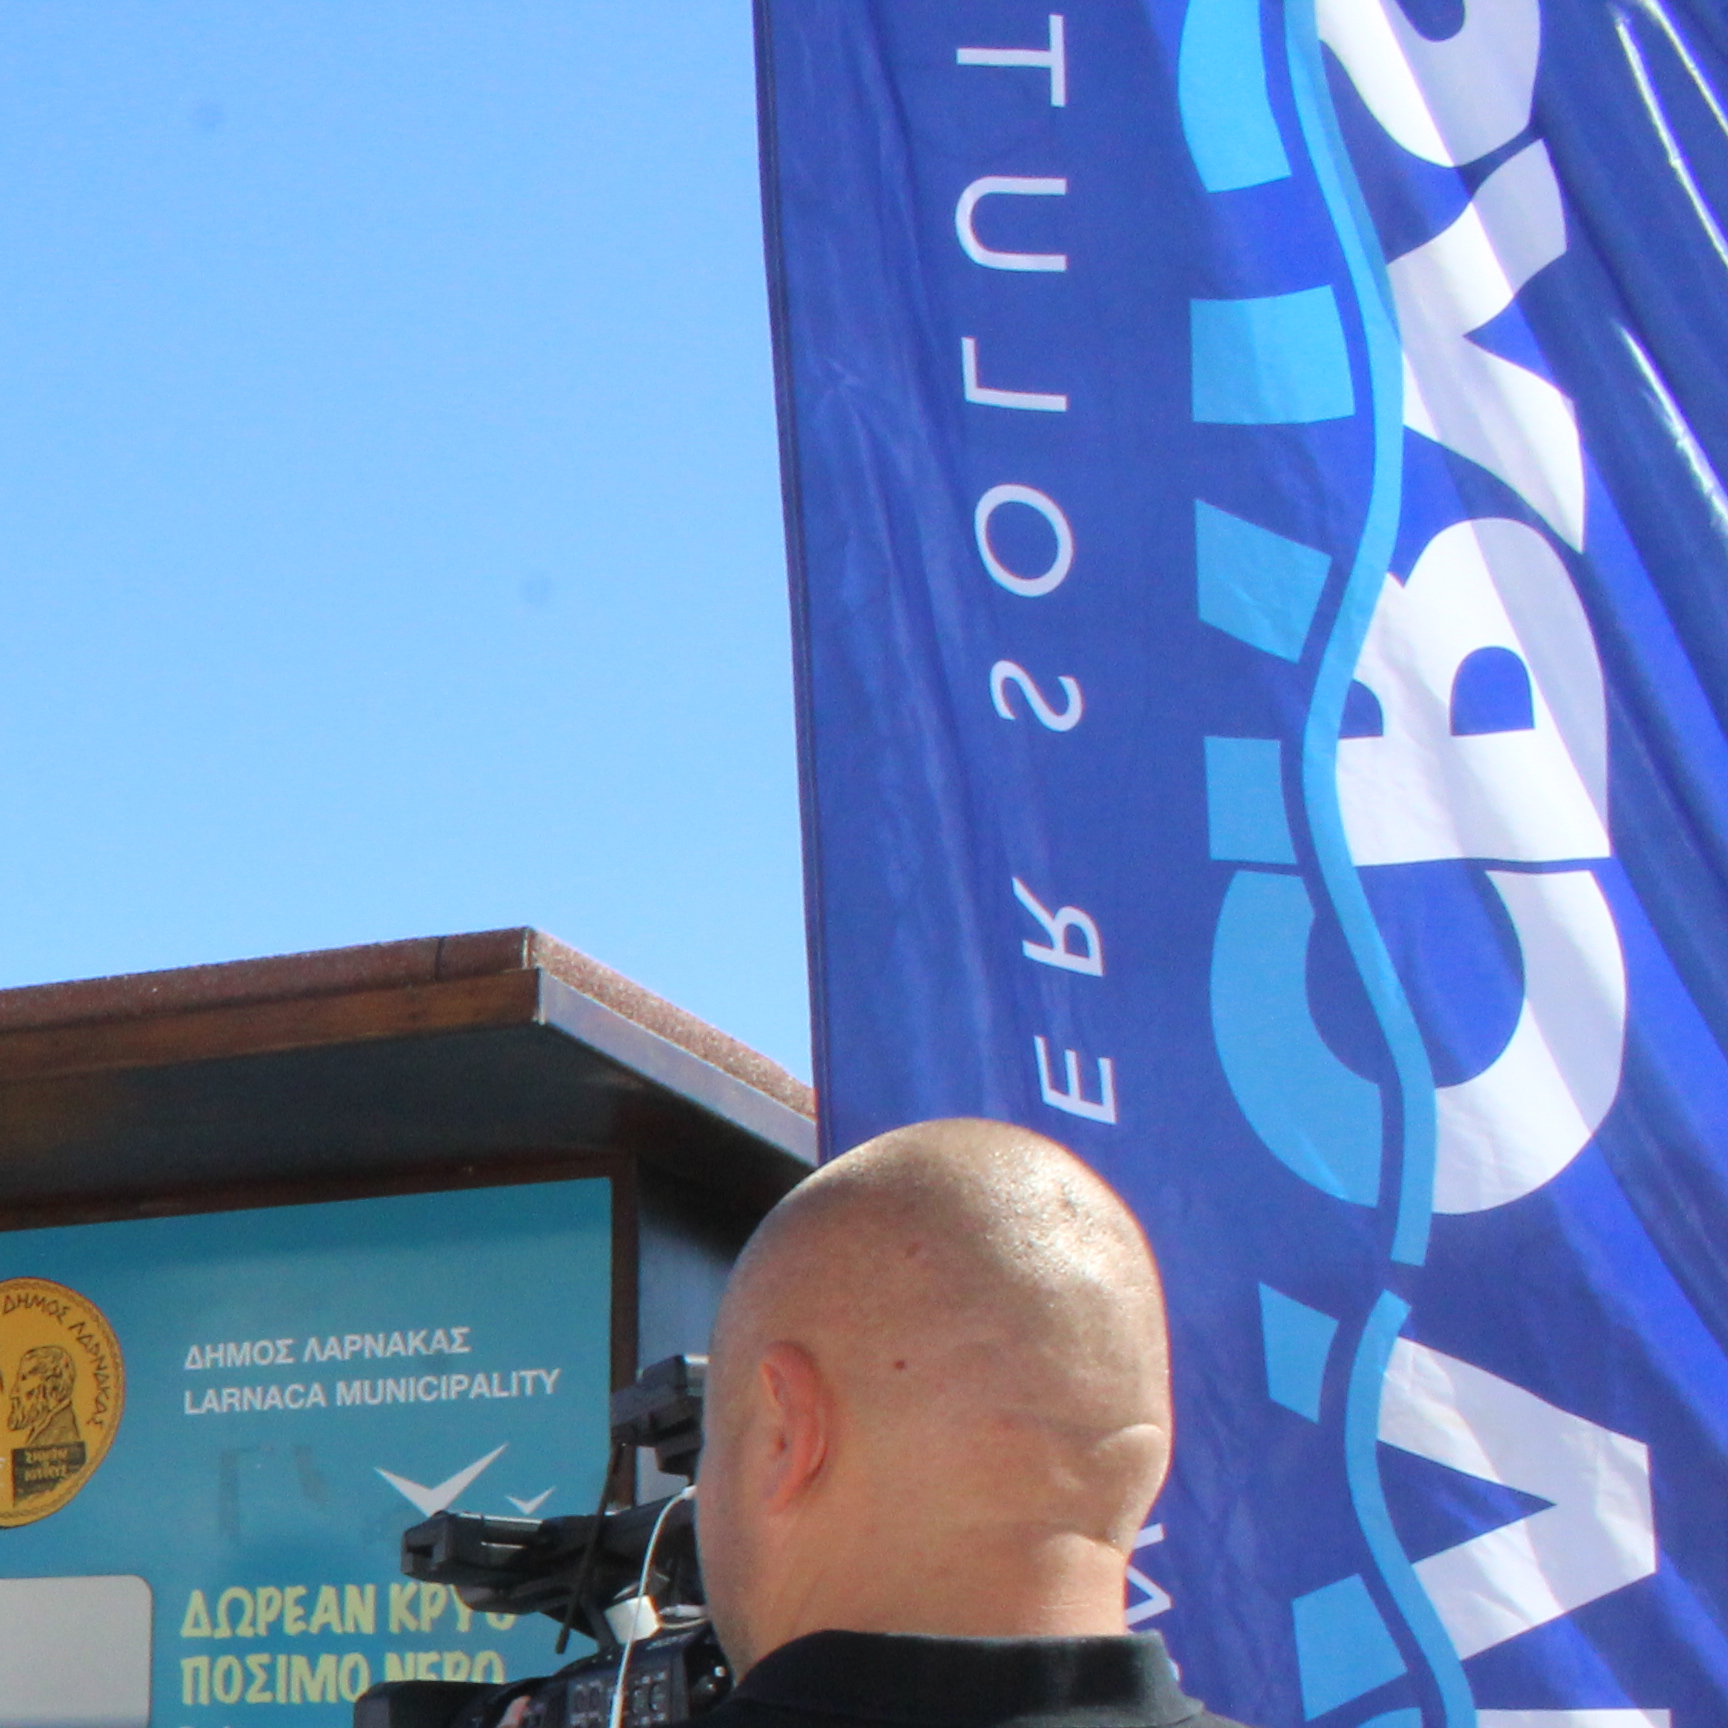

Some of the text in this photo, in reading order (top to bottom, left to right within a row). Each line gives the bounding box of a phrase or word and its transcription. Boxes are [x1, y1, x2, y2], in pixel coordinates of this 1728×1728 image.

[183, 1326, 473, 1371] ΔΗΜΟΣ ΛΑΡΝΑΚΑΣ
[183, 1367, 562, 1416] LARNACA MUNICIPALITY
[180, 1583, 377, 1638] ΔΩΡΕΑΝ
[180, 1652, 371, 1706] ΠΟΣΙΜΟ
